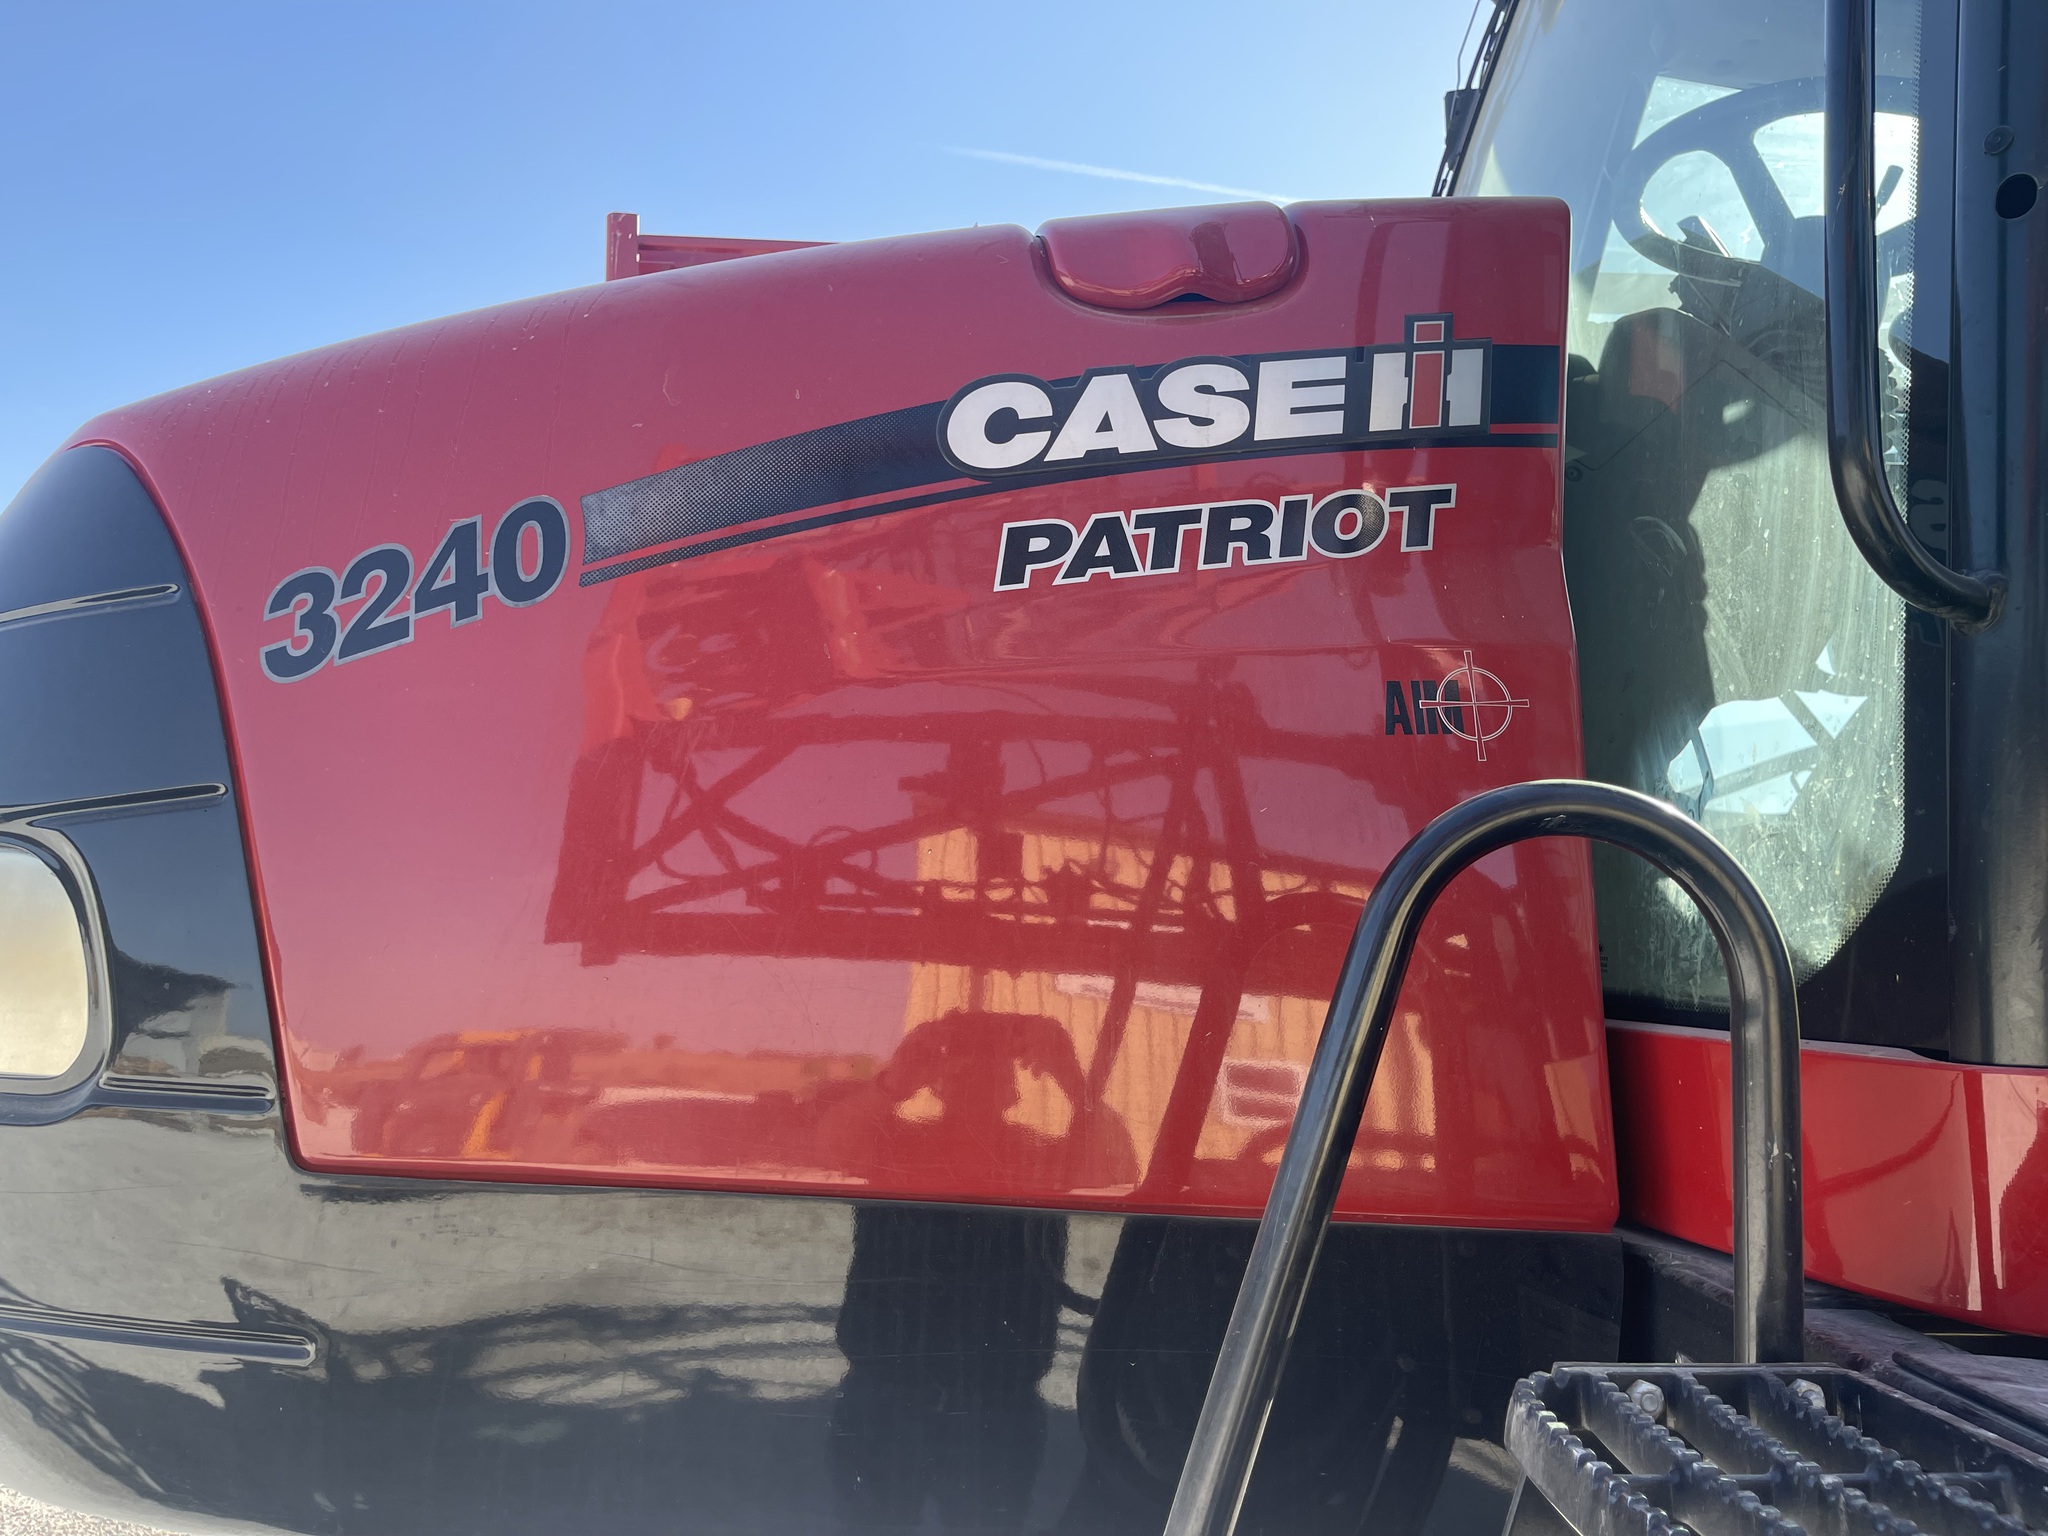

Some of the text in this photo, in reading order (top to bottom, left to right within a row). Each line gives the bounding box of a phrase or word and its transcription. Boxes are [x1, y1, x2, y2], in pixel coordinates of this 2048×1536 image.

[946, 356, 1347, 470] CASE
[259, 494, 571, 684] 3240
[993, 483, 1457, 592] PATRIOT
[1385, 680, 1465, 735] AIM
